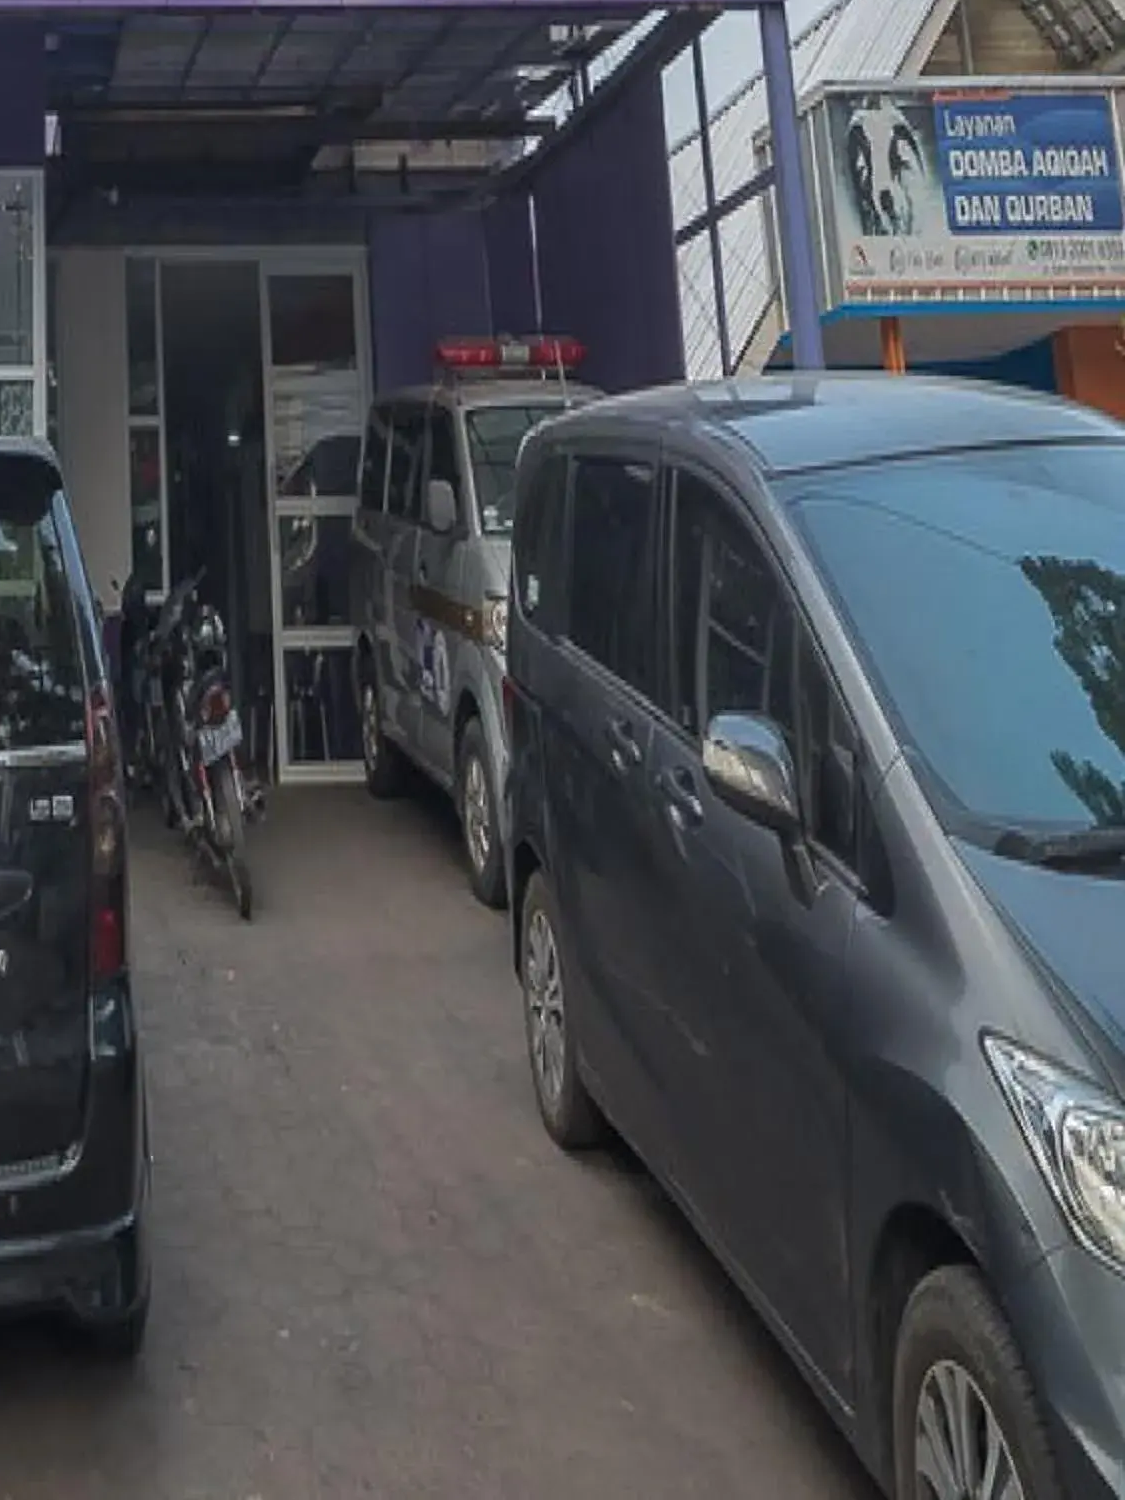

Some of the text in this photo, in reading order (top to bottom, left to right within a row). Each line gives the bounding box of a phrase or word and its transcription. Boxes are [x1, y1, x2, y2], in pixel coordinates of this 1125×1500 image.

[943, 109, 1016, 140] Layanan
[950, 147, 1109, 178] DOMBA AQIQAH
[954, 194, 1094, 225] DAN QURBAN
